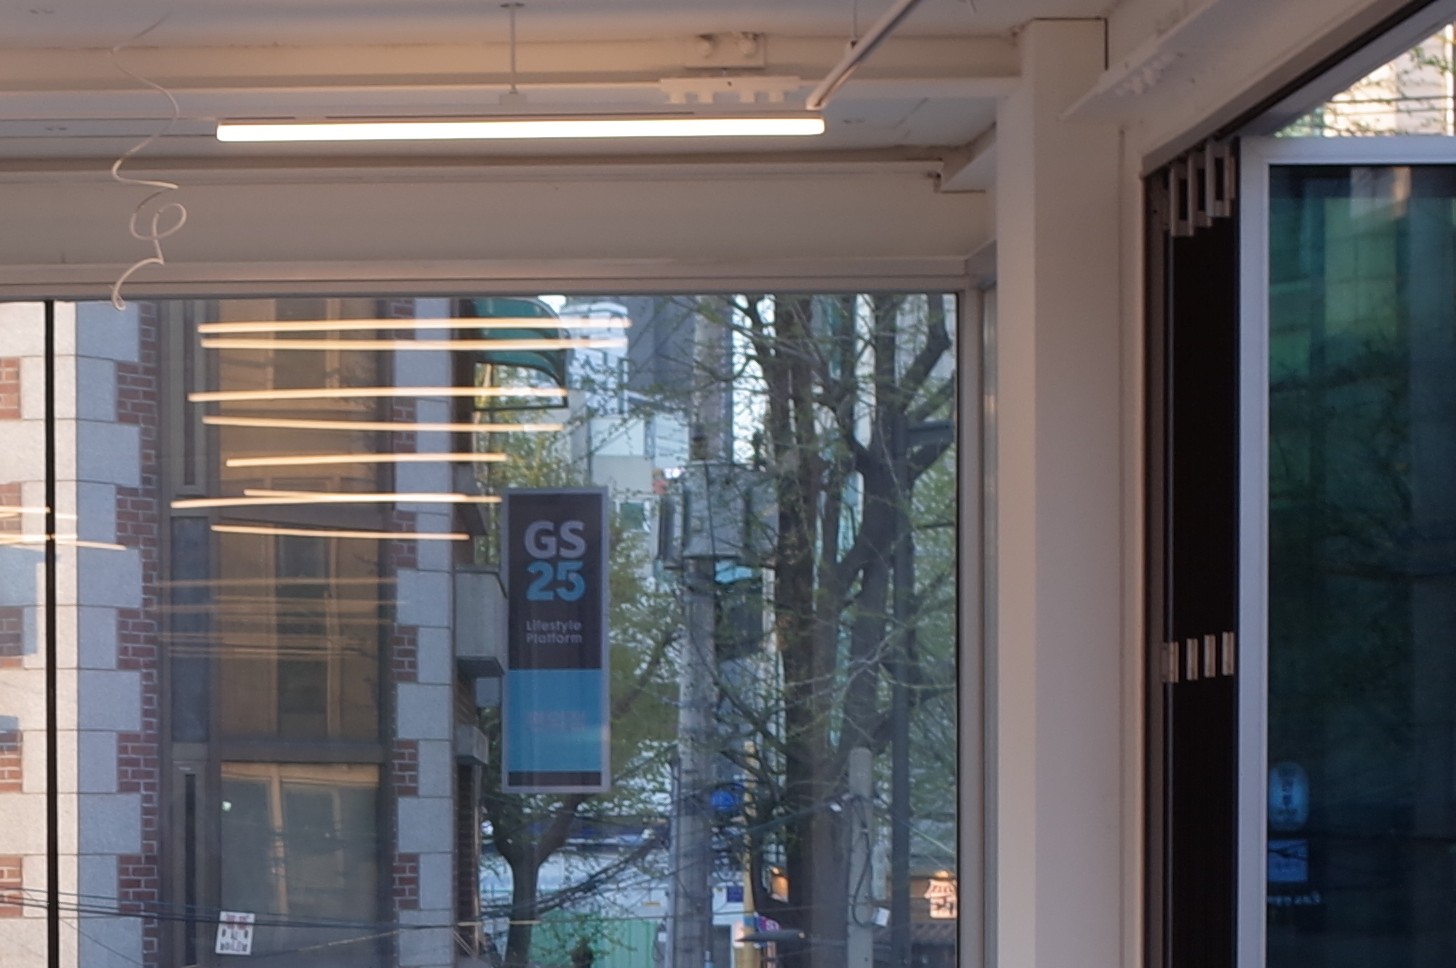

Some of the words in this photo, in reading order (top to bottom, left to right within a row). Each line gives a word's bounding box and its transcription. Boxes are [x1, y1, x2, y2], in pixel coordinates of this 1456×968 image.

[524, 520, 587, 559] GS
[526, 560, 586, 602] 25
[525, 619, 582, 633] Lifestyle
[525, 632, 583, 644] Platform
